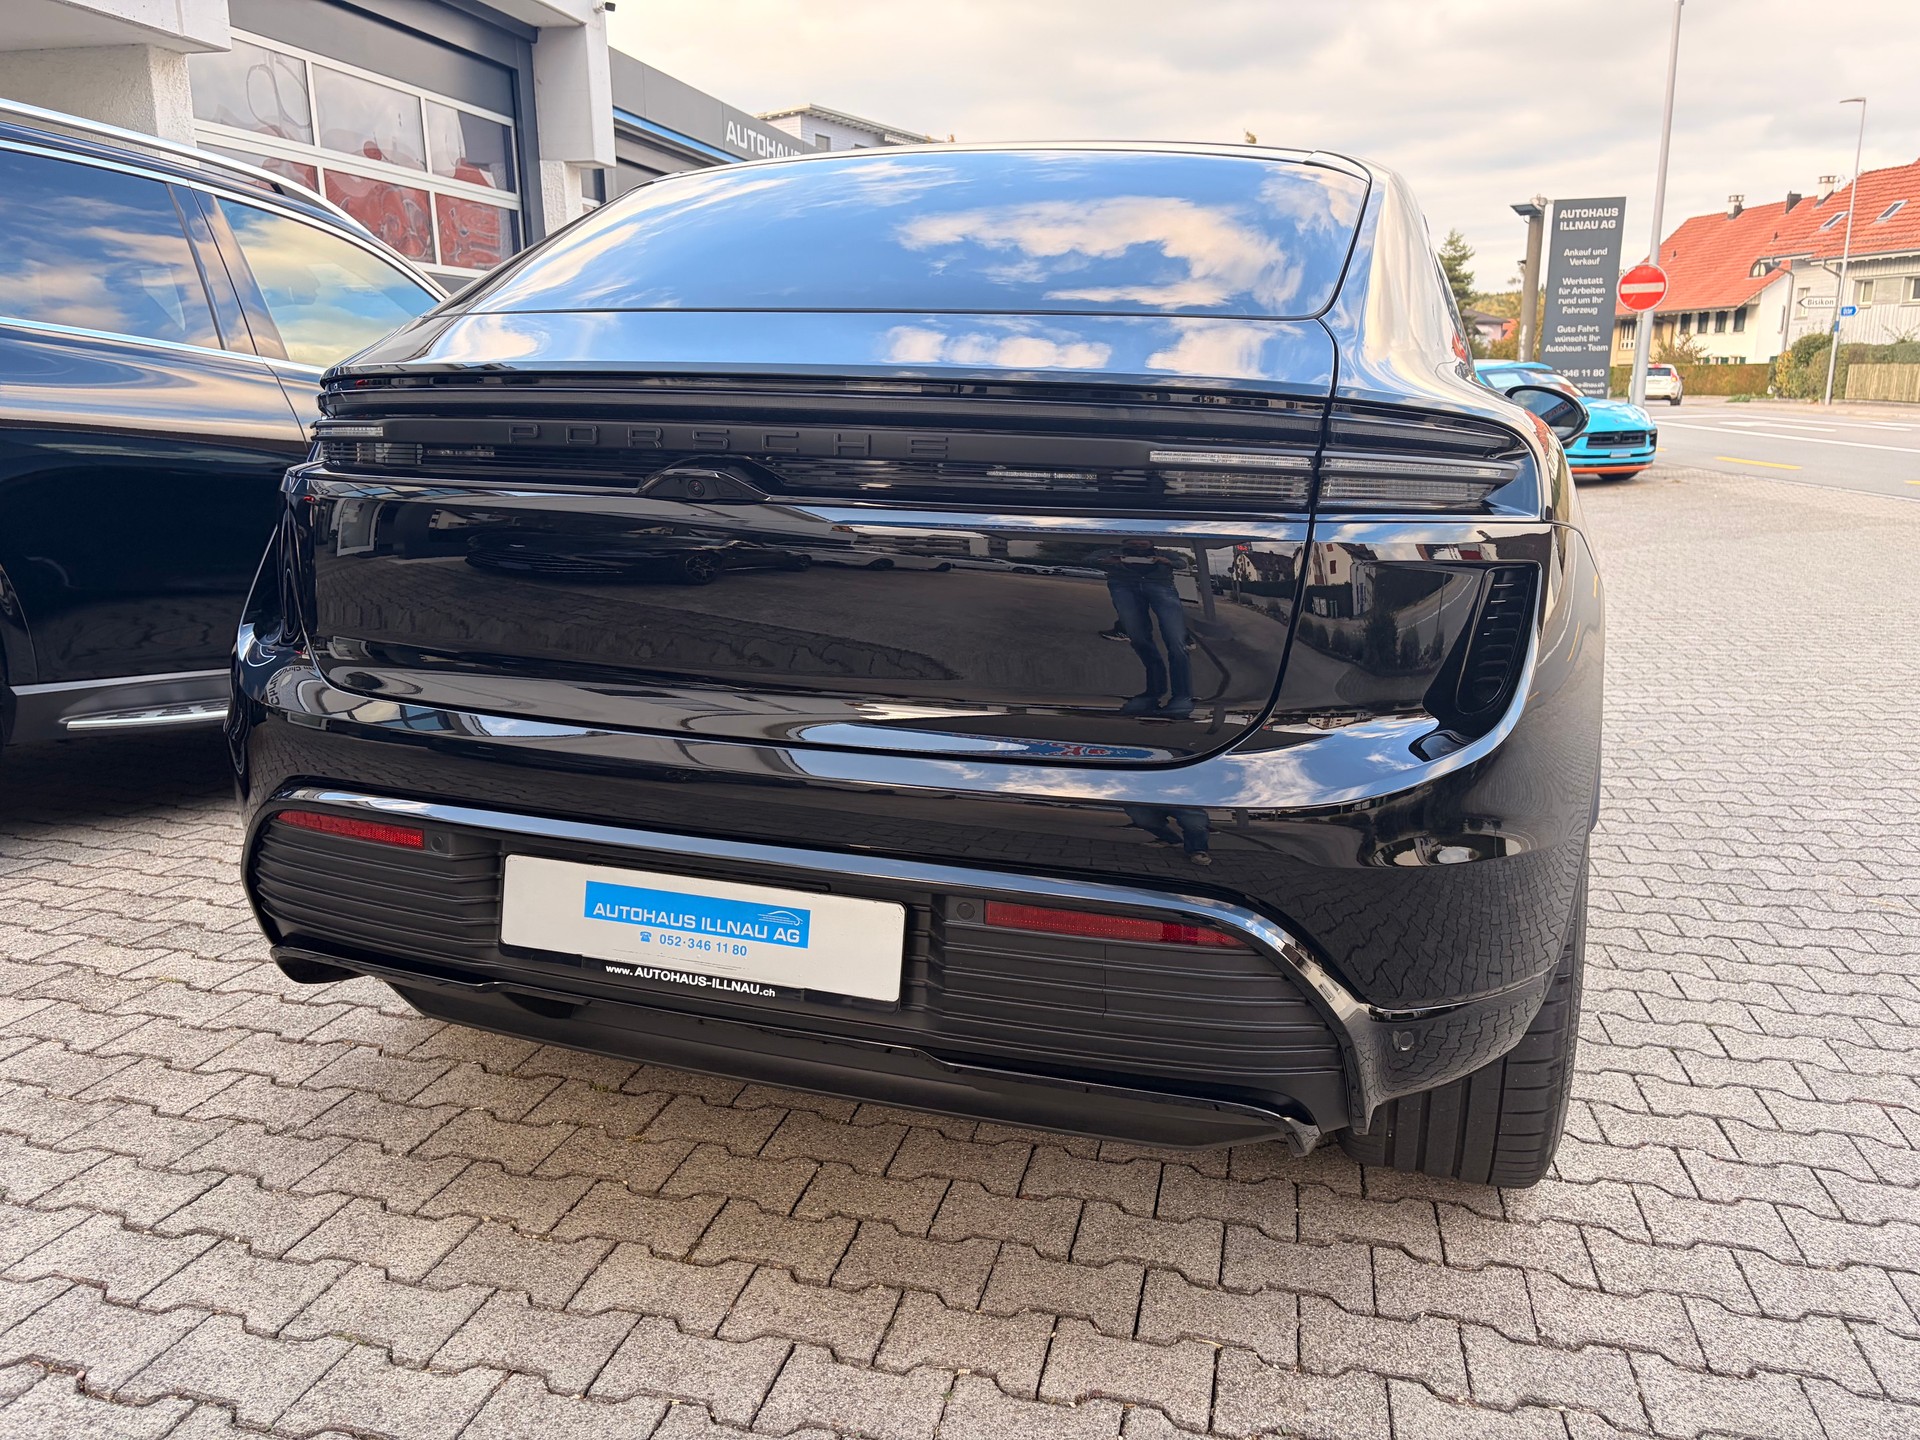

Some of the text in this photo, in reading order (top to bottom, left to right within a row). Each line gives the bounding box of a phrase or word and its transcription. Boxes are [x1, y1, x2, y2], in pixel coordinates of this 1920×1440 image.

[1560, 207, 1619, 219] AUTOHAUS
[1560, 220, 1616, 231] ILLNAU AG
[1563, 247, 1608, 256] Ankauf und
[1569, 257, 1600, 266] Verkauf
[1562, 277, 1604, 285] Werkstatt
[1558, 287, 1606, 295] für Arbeiten
[1558, 297, 1577, 305] rund
[1592, 296, 1604, 304] Ihr
[1562, 306, 1598, 315] Fahrzeug
[1557, 324, 1600, 333] Gute Fahrt
[1588, 334, 1601, 342] Ihr
[1545, 344, 1582, 352] Autohaus
[1587, 343, 1609, 351] Team
[1581, 369, 1591, 377] 11
[1592, 368, 1605, 377] 80
[508, 423, 949, 459] PORSCHE
[592, 902, 801, 944] AUTOHAUS ILLNAU AG
[716, 942, 729, 954] 11
[731, 944, 748, 957] 80
